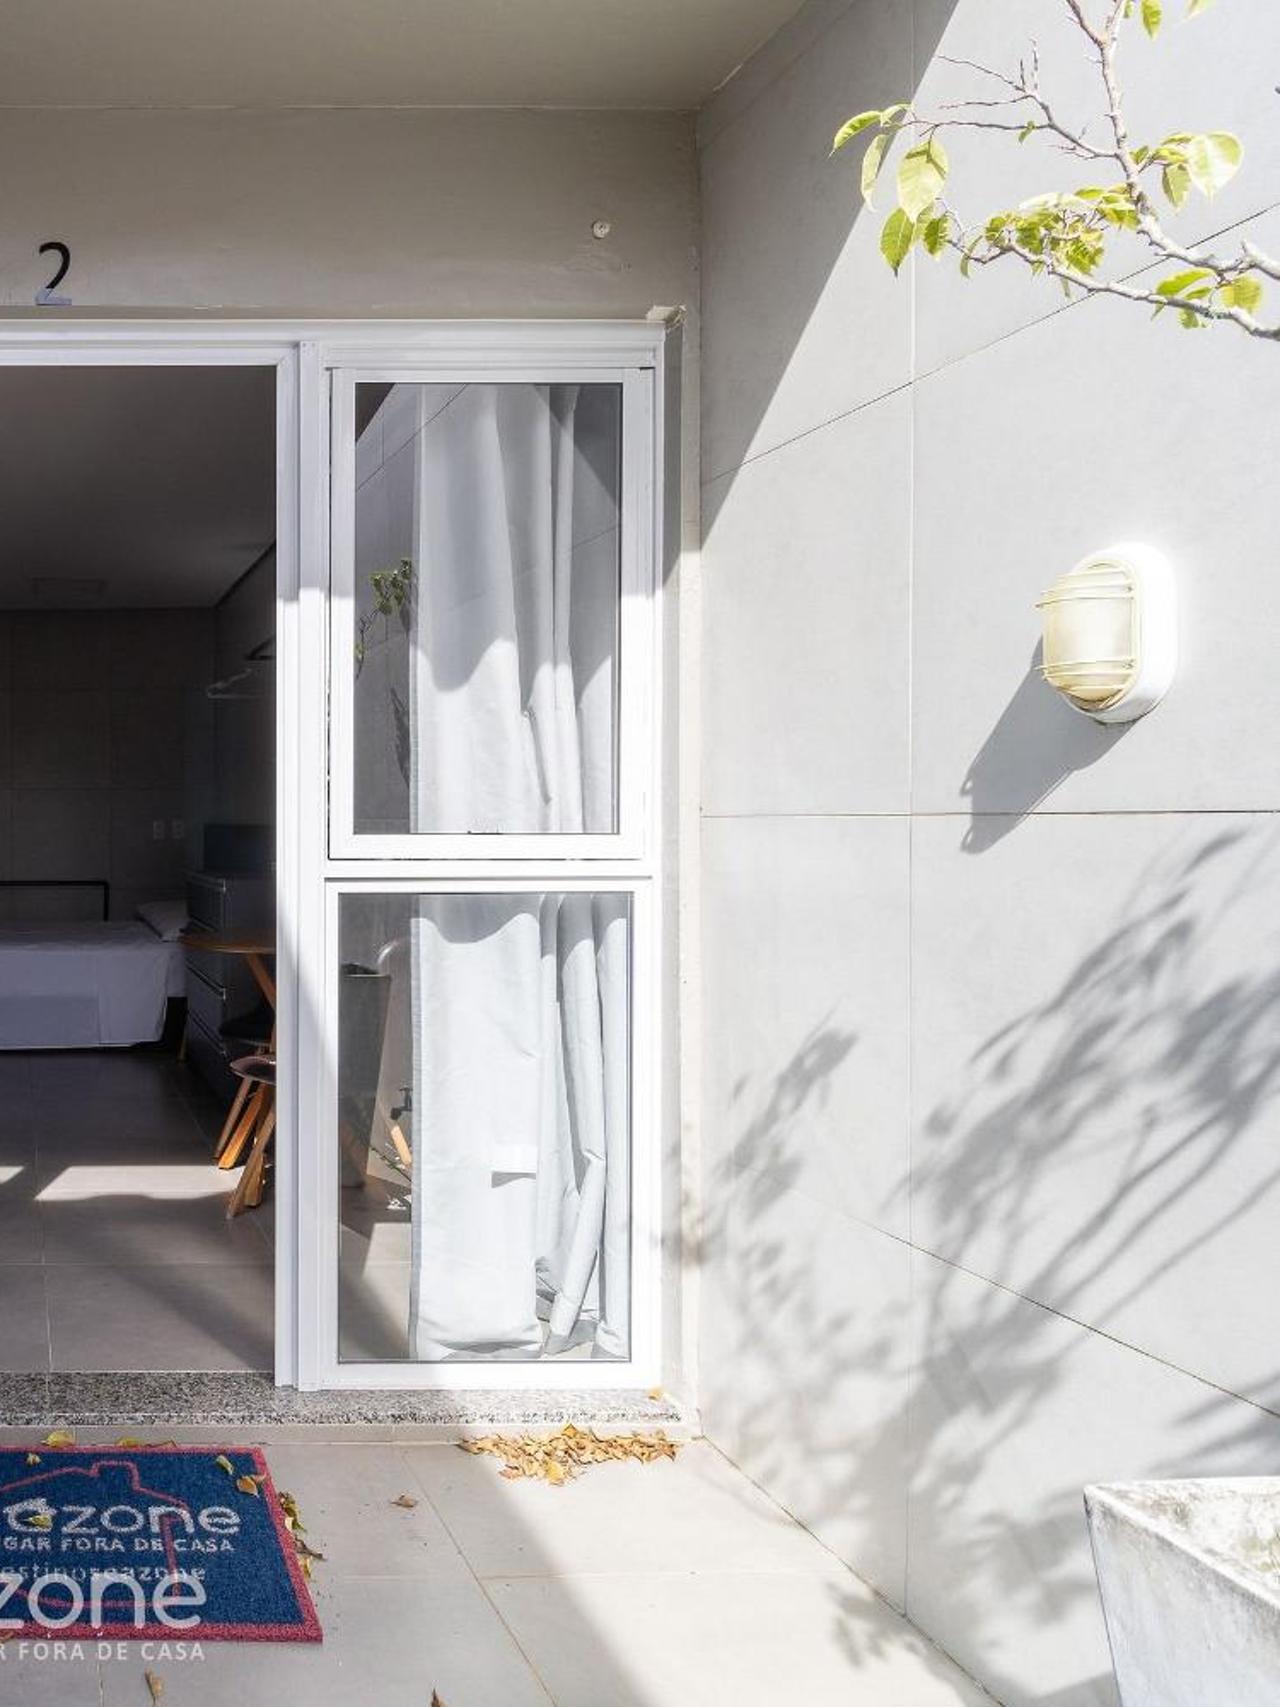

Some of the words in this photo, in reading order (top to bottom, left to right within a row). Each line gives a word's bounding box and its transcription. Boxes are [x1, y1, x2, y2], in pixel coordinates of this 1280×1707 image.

[36, 241, 72, 306] 2
[61, 1537, 124, 1551] FORA
[134, 1537, 164, 1551] DE
[174, 1538, 234, 1551] CASA
